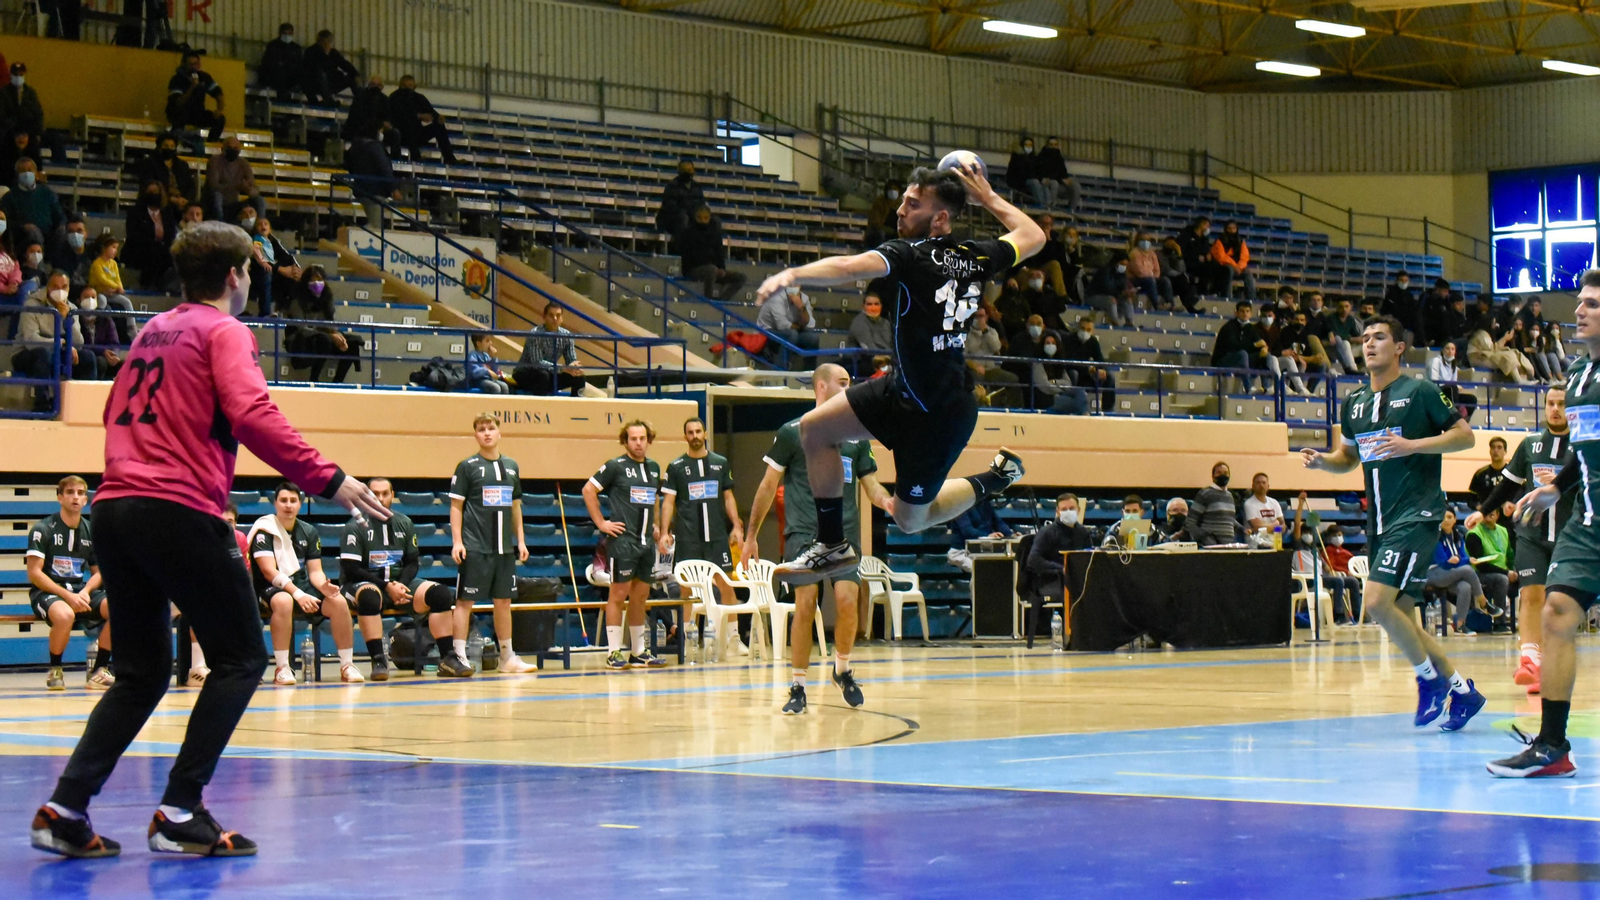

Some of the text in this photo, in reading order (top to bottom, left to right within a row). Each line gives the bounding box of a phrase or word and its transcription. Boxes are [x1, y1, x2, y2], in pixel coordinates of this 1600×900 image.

[390, 249, 456, 269] Delegación
[115, 356, 164, 426] 22
[493, 410, 552, 425] PRENSA
[605, 412, 626, 425] TV
[1351, 402, 1365, 420] 31
[1531, 441, 1544, 454] 10
[479, 466, 486, 478] 7
[625, 467, 638, 479] 64
[684, 465, 692, 476] 5
[53, 533, 64, 546] 16
[722, 552, 729, 563] 5
[1381, 549, 1400, 568] 31
